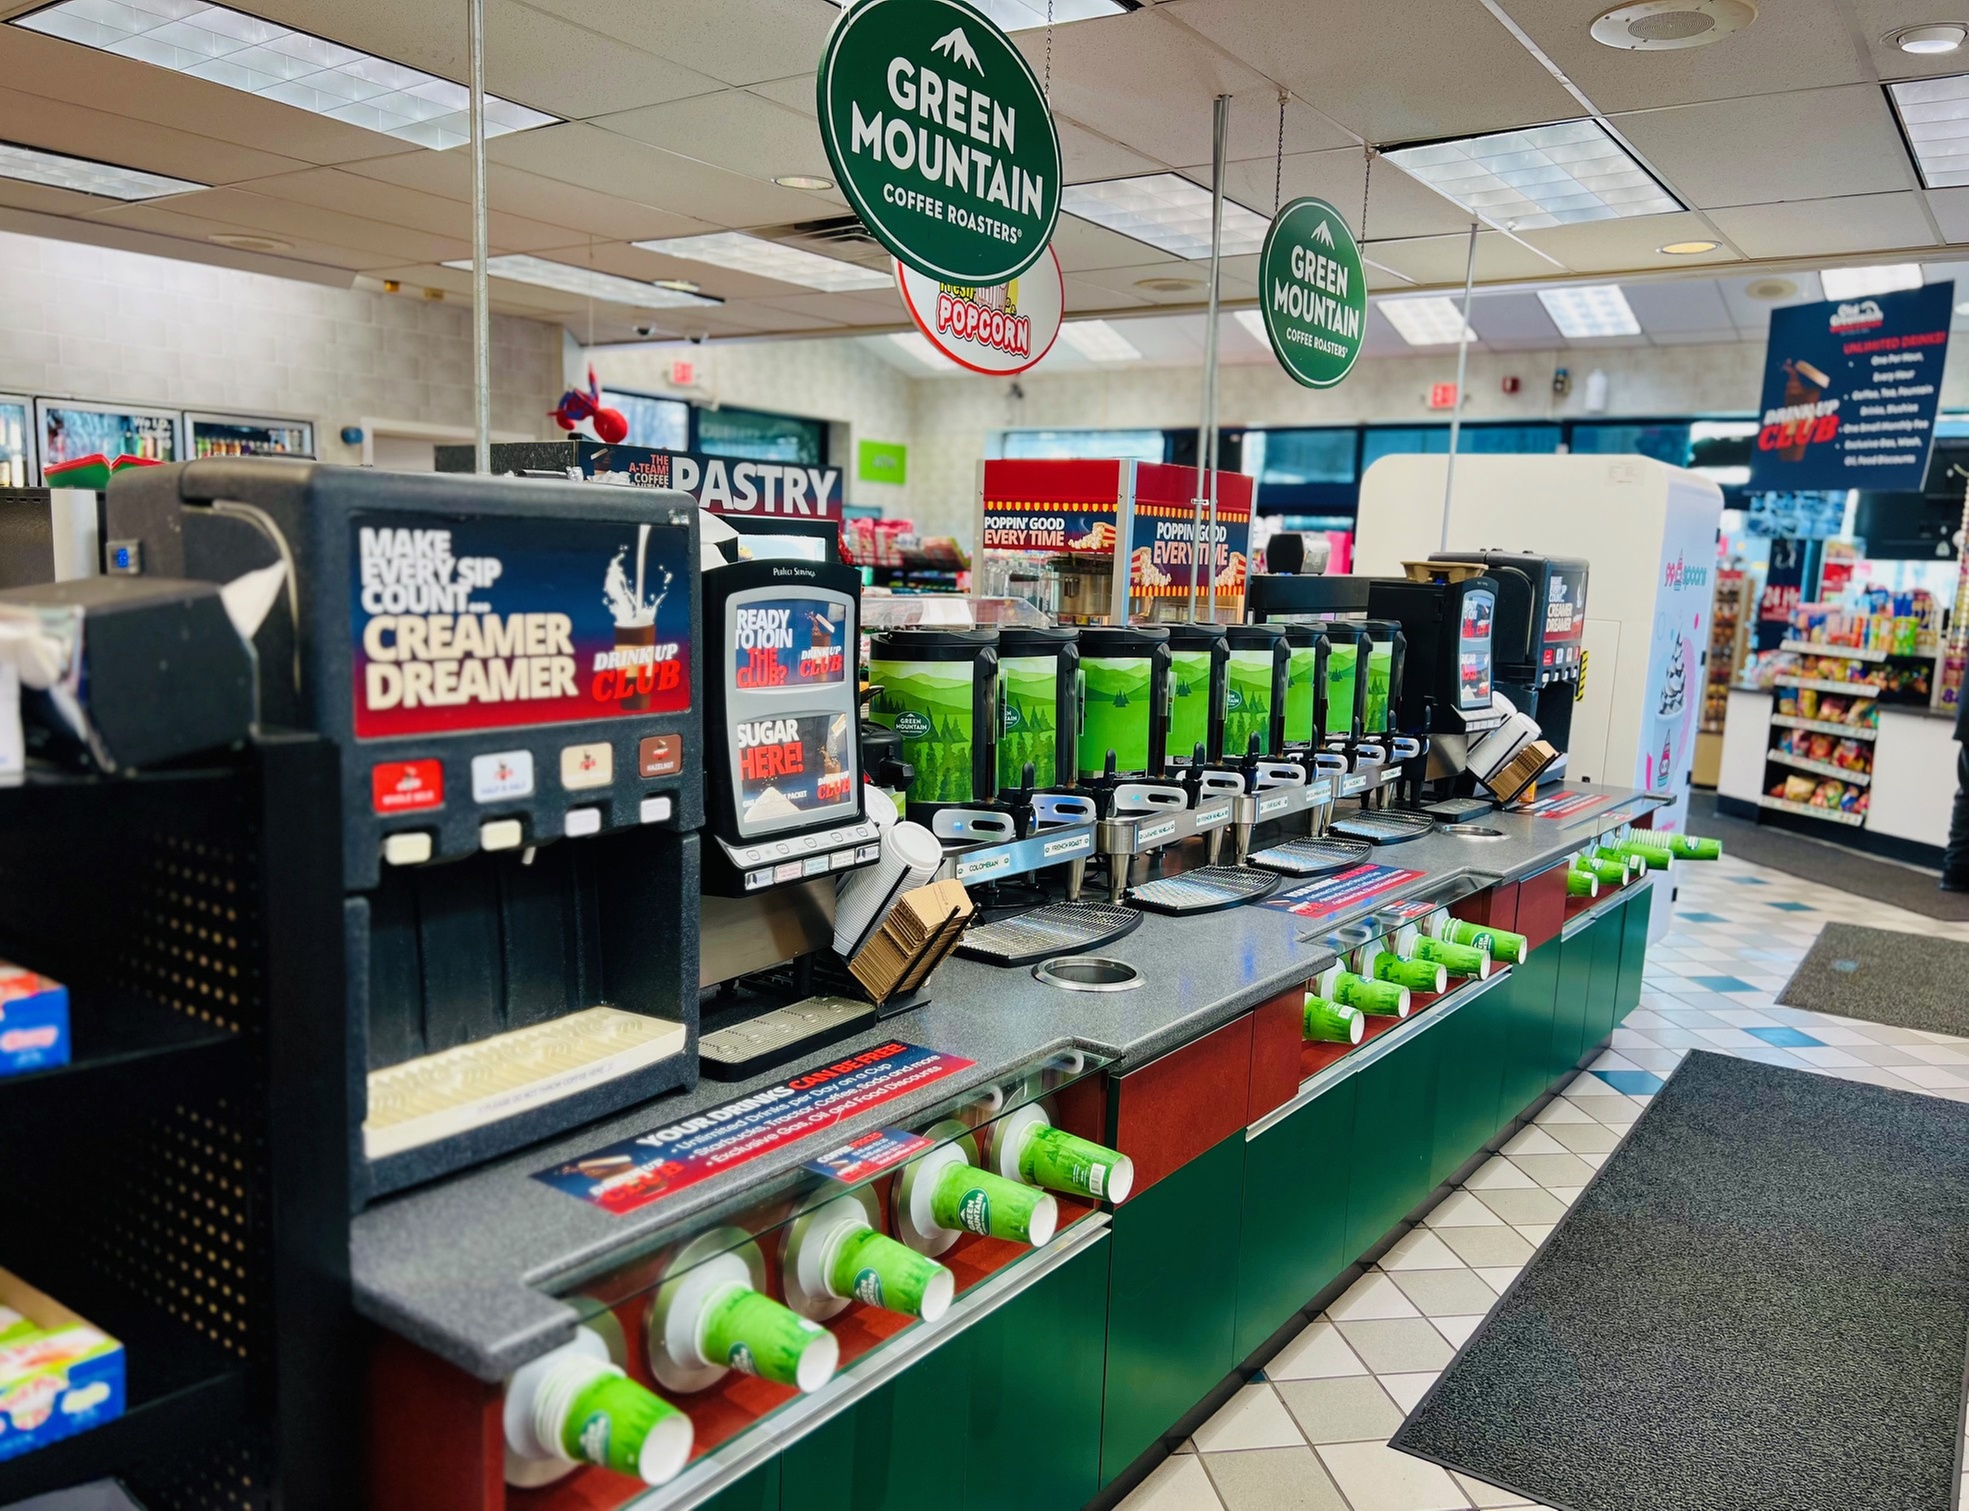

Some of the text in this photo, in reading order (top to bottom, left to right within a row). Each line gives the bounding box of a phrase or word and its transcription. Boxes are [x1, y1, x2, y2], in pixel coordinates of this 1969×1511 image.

[887, 56, 1015, 155] GREEN
[851, 100, 1044, 220] MOUNTAIN
[883, 183, 944, 220] COFFEE
[1291, 245, 1349, 299] GREEN
[1274, 277, 1360, 340] MOUNTAIN
[937, 293, 1030, 358] POPCORN
[1286, 327, 1313, 347] COFFEE
[1897, 384, 1935, 396] Fountain
[1763, 398, 1840, 426] DRINK UP
[1758, 414, 1840, 450] CLUB
[650, 454, 669, 465] THE
[628, 456, 838, 517] A-TEAM! PASTRY
[634, 472, 669, 485] COFFEE
[984, 516, 1065, 531] POPPIN' GOOD
[984, 529, 1065, 547] EVERY TIME
[360, 527, 452, 559] MAKE
[1153, 540, 1197, 565] EVERY
[361, 556, 503, 589] EVERY SIP
[736, 609, 791, 630] READY
[363, 613, 575, 662] CREAMER
[735, 628, 793, 650] TO JOIN
[829, 645, 842, 657] UP
[593, 644, 680, 672] DRINK UP
[747, 647, 778, 669] THE
[800, 654, 843, 678] CLUB
[365, 656, 579, 711] DREAMER
[591, 659, 682, 703] CLUB
[736, 665, 790, 688] CLUB?
[737, 719, 800, 748] SUGAR
[646, 761, 674, 772] HAZELNUT
[739, 741, 805, 781] HERE!
[817, 777, 850, 800] CLUB
[969, 860, 999, 872] COLOMBIAN
[636, 1116, 718, 1147] YOUR
[706, 1085, 795, 1125] DRINKS
[788, 1069, 838, 1090] CAN
[829, 1059, 862, 1075] BE
[675, 1119, 748, 1150] Unlimited
[745, 1103, 790, 1123] Drinks
[788, 1092, 812, 1107] per
[811, 1084, 840, 1097] Day
[840, 1077, 858, 1086] on
[864, 1063, 892, 1076] Cup
[693, 1125, 771, 1157] Starbucks,
[815, 1084, 861, 1107] Coffee,
[861, 1074, 892, 1089] Soda
[889, 1065, 913, 1078] and
[911, 1054, 941, 1069] more
[710, 1065, 942, 1163] Exclusive Gas, Oil and Food Discounts
[601, 1160, 684, 1203] CLUB
[967, 1199, 976, 1231] GREEN
